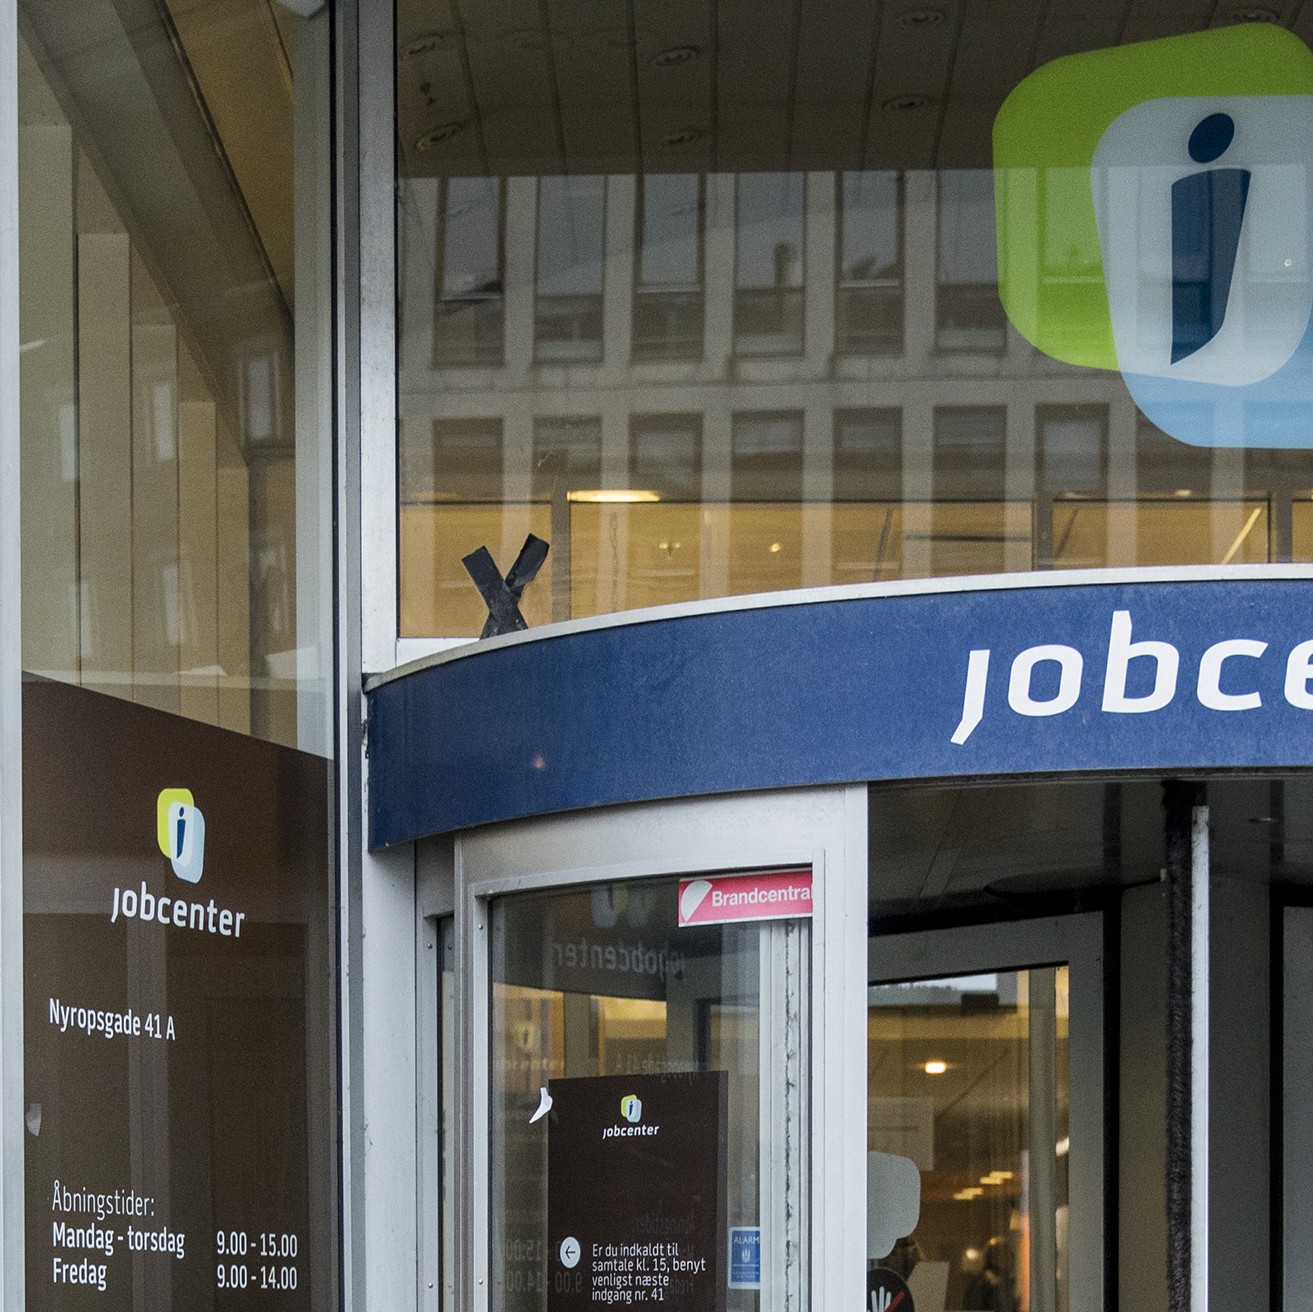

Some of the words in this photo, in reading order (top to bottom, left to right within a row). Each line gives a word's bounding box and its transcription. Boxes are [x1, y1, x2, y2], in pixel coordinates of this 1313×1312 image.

[111, 880, 246, 938] jobcenter
[50, 998, 140, 1038] Nyropsgade
[145, 1013, 162, 1038] 41
[166, 1016, 175, 1040] A
[603, 1125, 659, 1139] jobcenter
[52, 1180, 154, 1220] Åbningstider:
[53, 1222, 114, 1256] Mandag
[127, 1226, 185, 1259] torsdag
[217, 1231, 247, 1255] 9.00
[261, 1233, 297, 1257] 15.00
[593, 1244, 603, 1257] Er
[605, 1244, 617, 1257] du
[621, 1243, 664, 1256] indkaldt
[667, 1243, 678, 1256] til
[54, 1258, 107, 1291] Fredag
[217, 1264, 247, 1288] 9.00
[261, 1266, 297, 1289] 14.00
[592, 1258, 633, 1271] samtale
[637, 1258, 649, 1271] kl.
[653, 1258, 669, 1273] 15,
[673, 1257, 705, 1274] benyt
[592, 1273, 632, 1289] venligst
[636, 1273, 669, 1286] næste
[592, 1285, 632, 1304] indgang
[635, 1291, 648, 1300] nr.
[651, 1288, 663, 1300] 41
